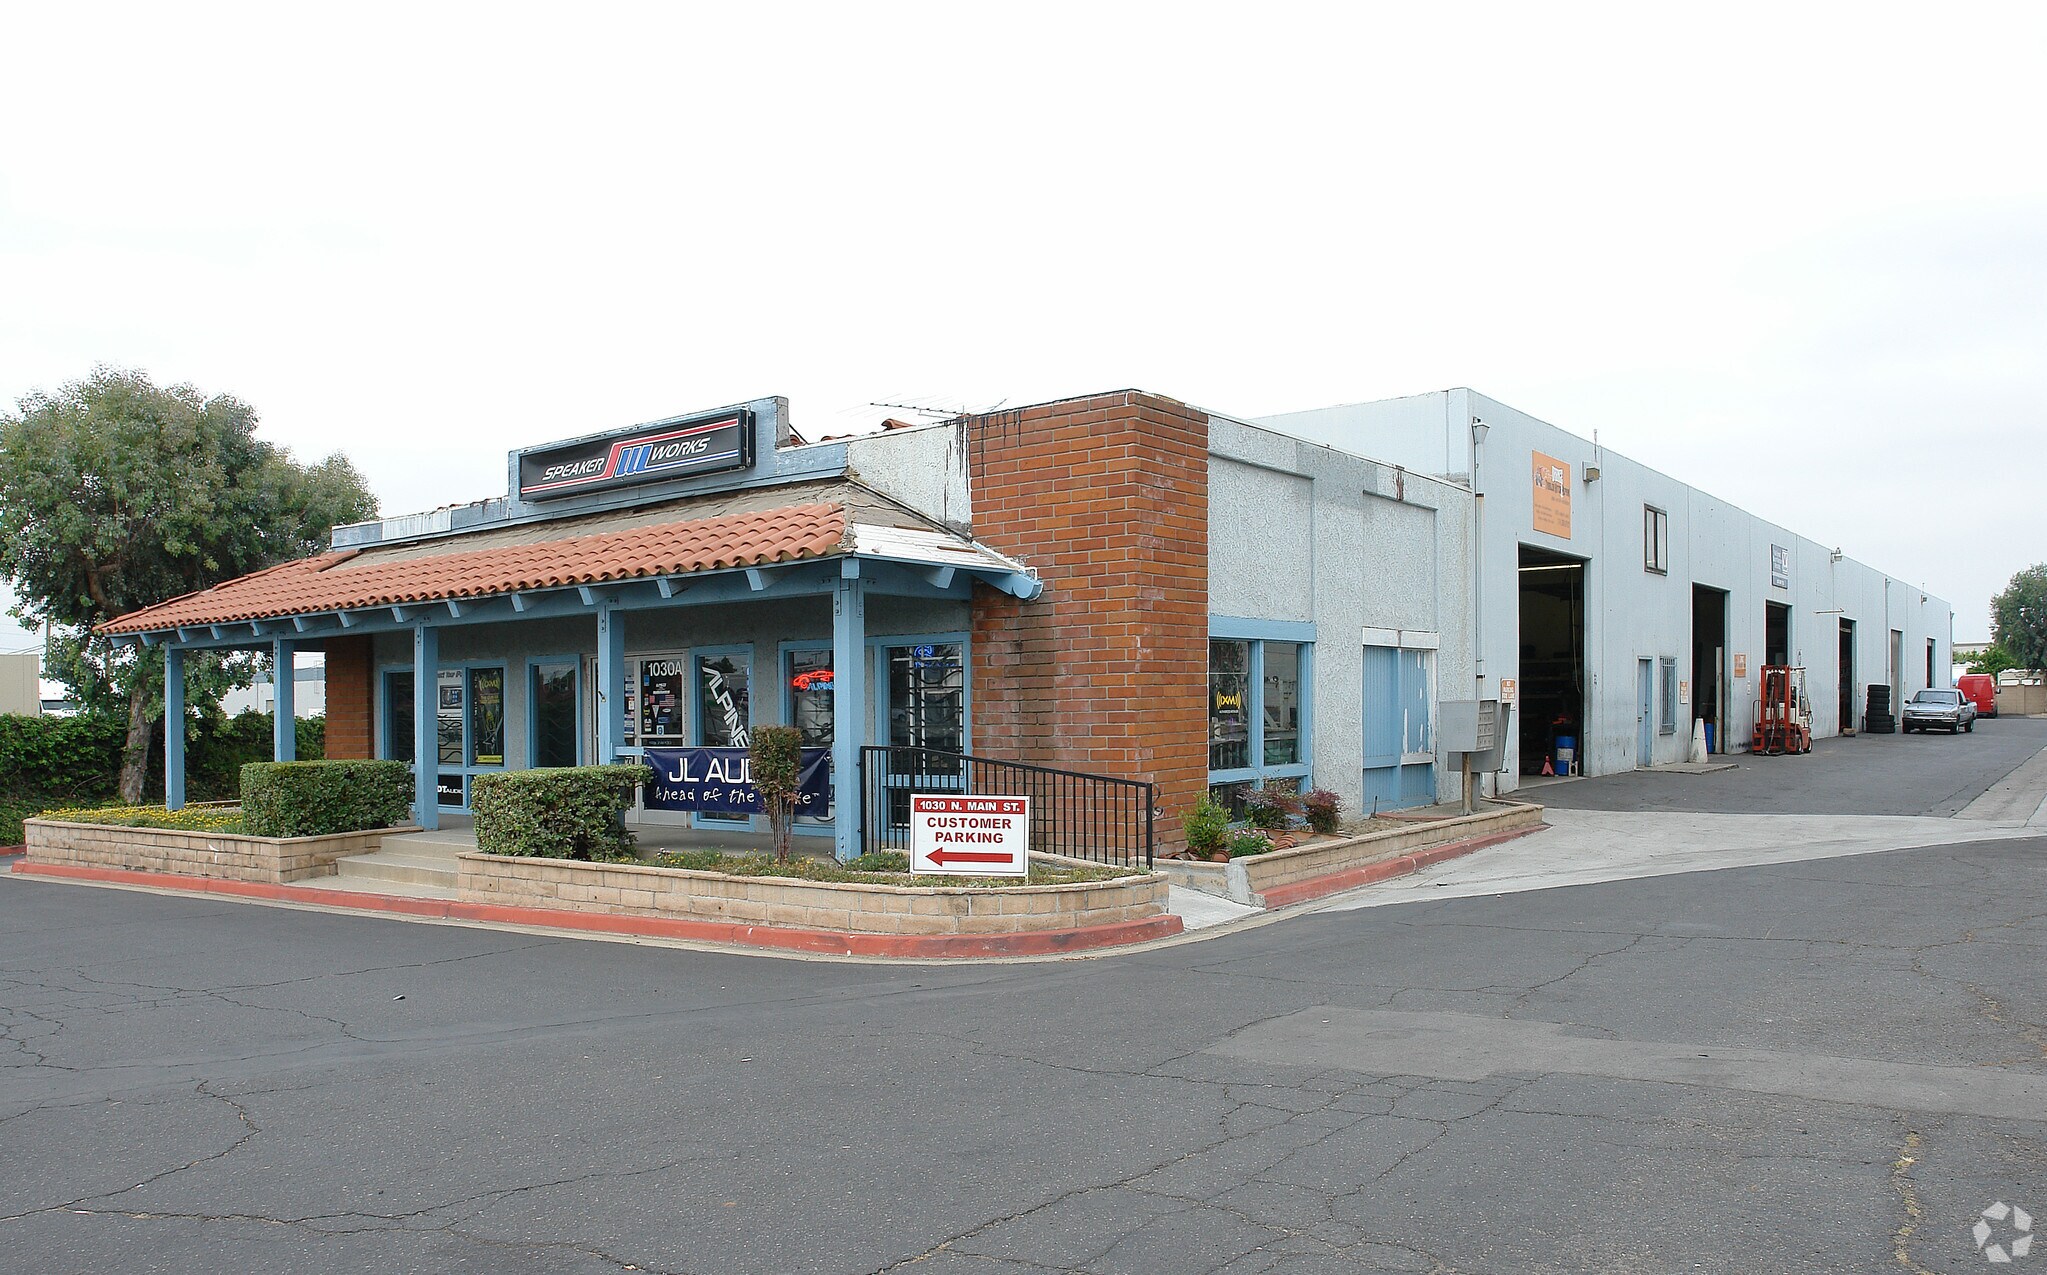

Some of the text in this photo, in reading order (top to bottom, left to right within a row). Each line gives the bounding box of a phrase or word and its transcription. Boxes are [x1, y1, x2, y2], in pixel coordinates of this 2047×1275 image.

[542, 437, 711, 481] SPEAKER WORKS
[648, 661, 683, 677] 1030A
[702, 666, 749, 748] ALPINE
[668, 757, 700, 782] JL
[703, 787, 723, 802] of
[729, 788, 755, 804] the
[920, 800, 1020, 812] 1030 N. MAIN ST.
[927, 817, 1012, 829] CUSTOMER
[935, 831, 1004, 843] PARKING
